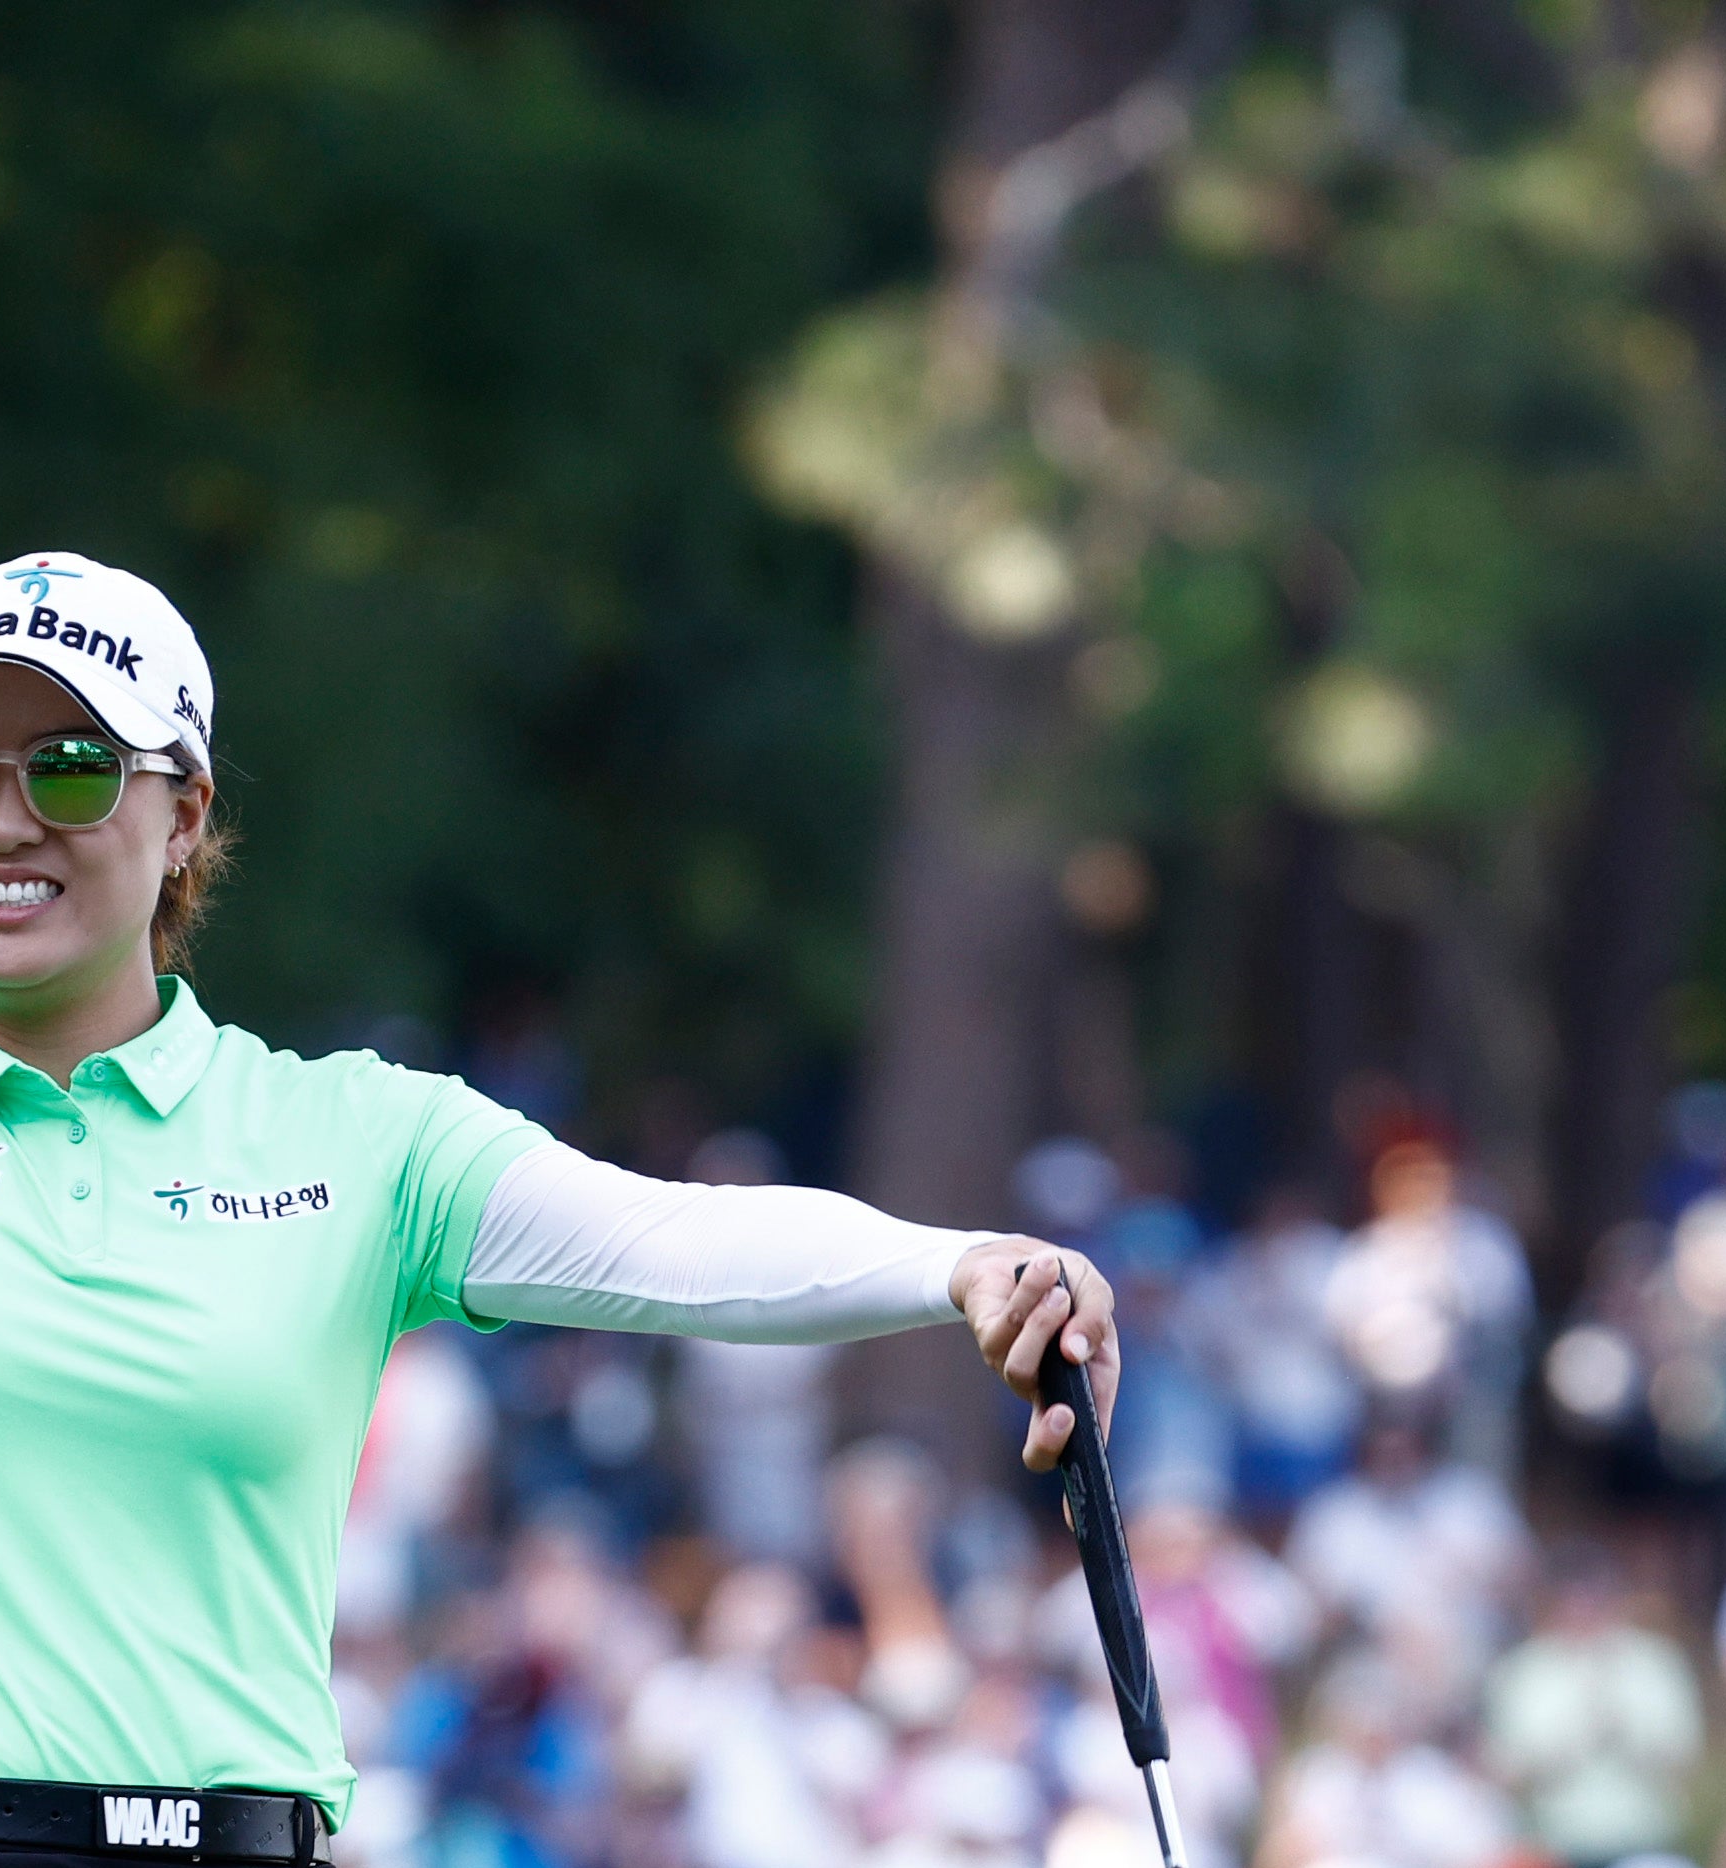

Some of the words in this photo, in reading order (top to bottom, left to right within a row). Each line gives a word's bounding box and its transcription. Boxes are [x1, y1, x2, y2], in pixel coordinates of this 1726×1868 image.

[28, 607, 143, 681] Bank
[211, 1183, 328, 1219] 하나은행
[104, 1796, 200, 1847] WAAC
